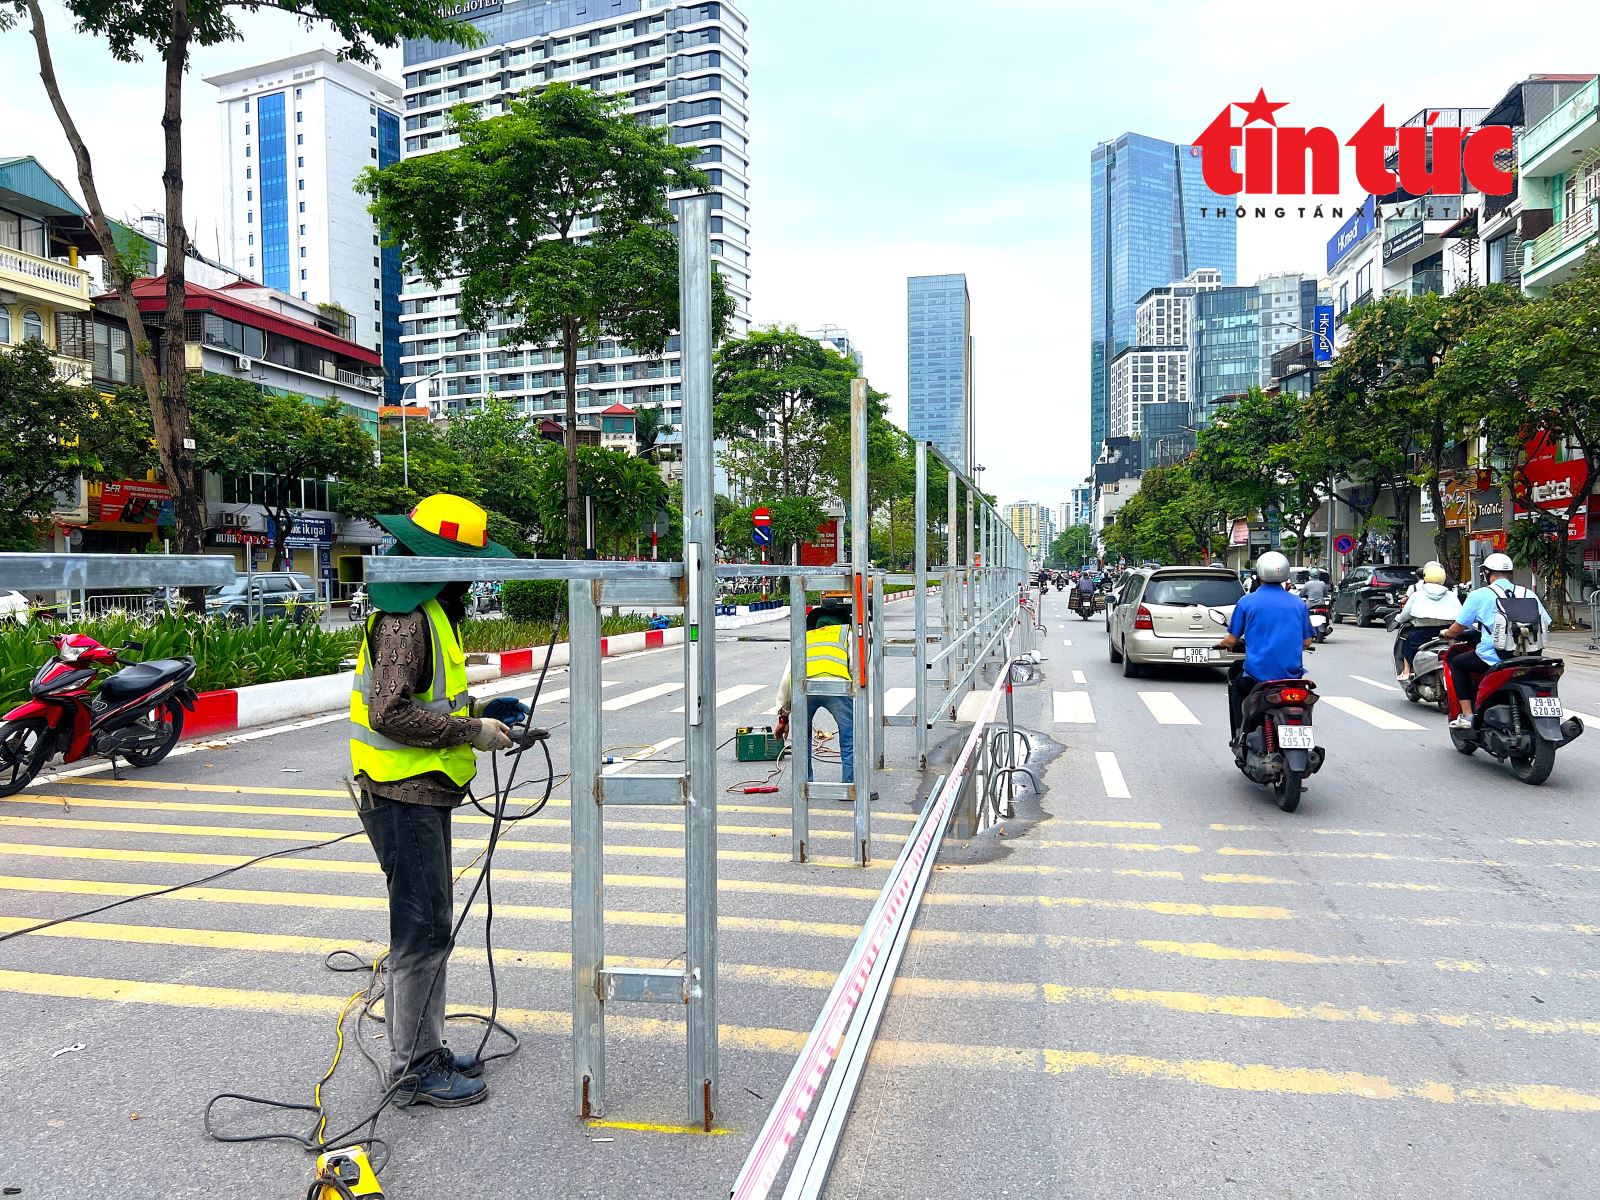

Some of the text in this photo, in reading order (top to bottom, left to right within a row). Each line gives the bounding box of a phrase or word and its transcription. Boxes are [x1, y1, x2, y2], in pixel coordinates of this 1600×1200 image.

[104, 483, 121, 493] SFR
[1190, 648, 1204, 656] 30E
[1533, 698, 1556, 707] 29-B1
[1533, 707, 1561, 716] 520.99
[1283, 727, 1308, 737] 29-AC
[1282, 737, 1311, 747] 295.17
